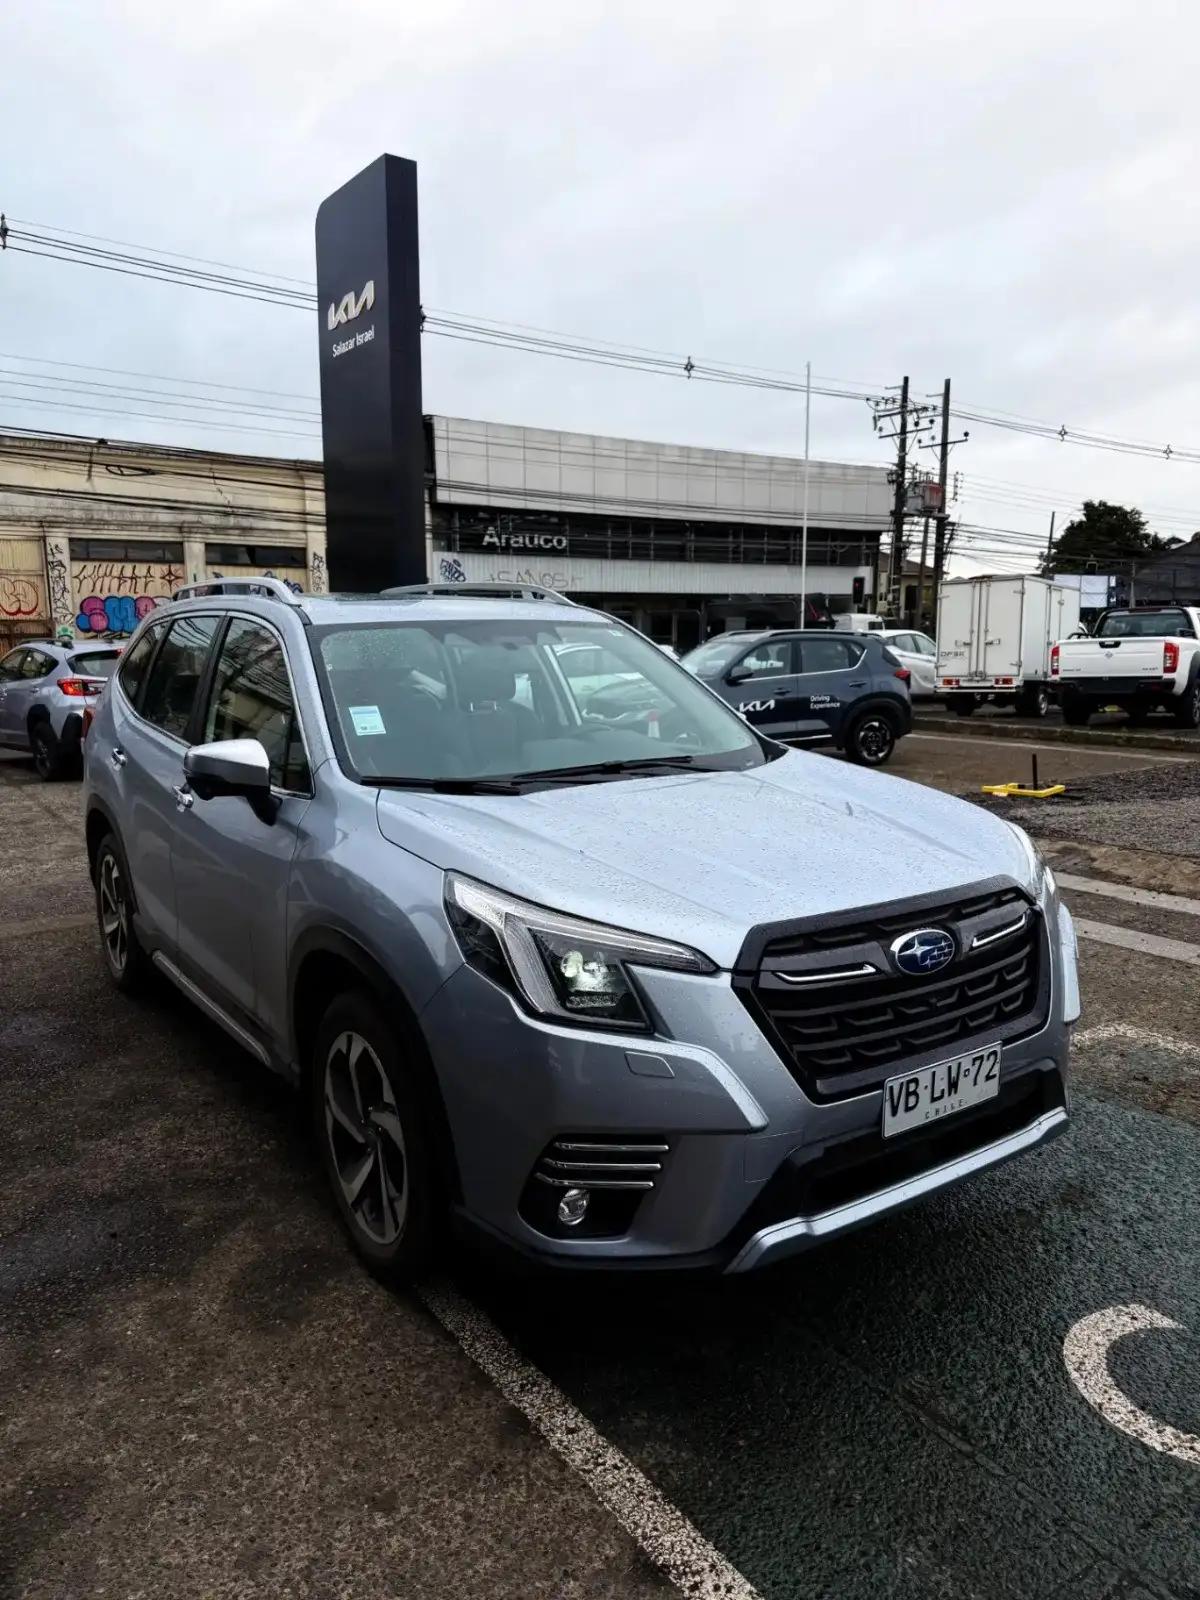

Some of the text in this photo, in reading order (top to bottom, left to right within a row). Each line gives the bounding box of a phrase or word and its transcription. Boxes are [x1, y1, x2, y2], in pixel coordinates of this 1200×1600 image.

[328, 280, 374, 330] KIA
[333, 325, 374, 357] Salazar Israel
[482, 527, 567, 549] Arauco
[740, 699, 775, 712] KIA
[925, 1099, 964, 1119] CHILE
